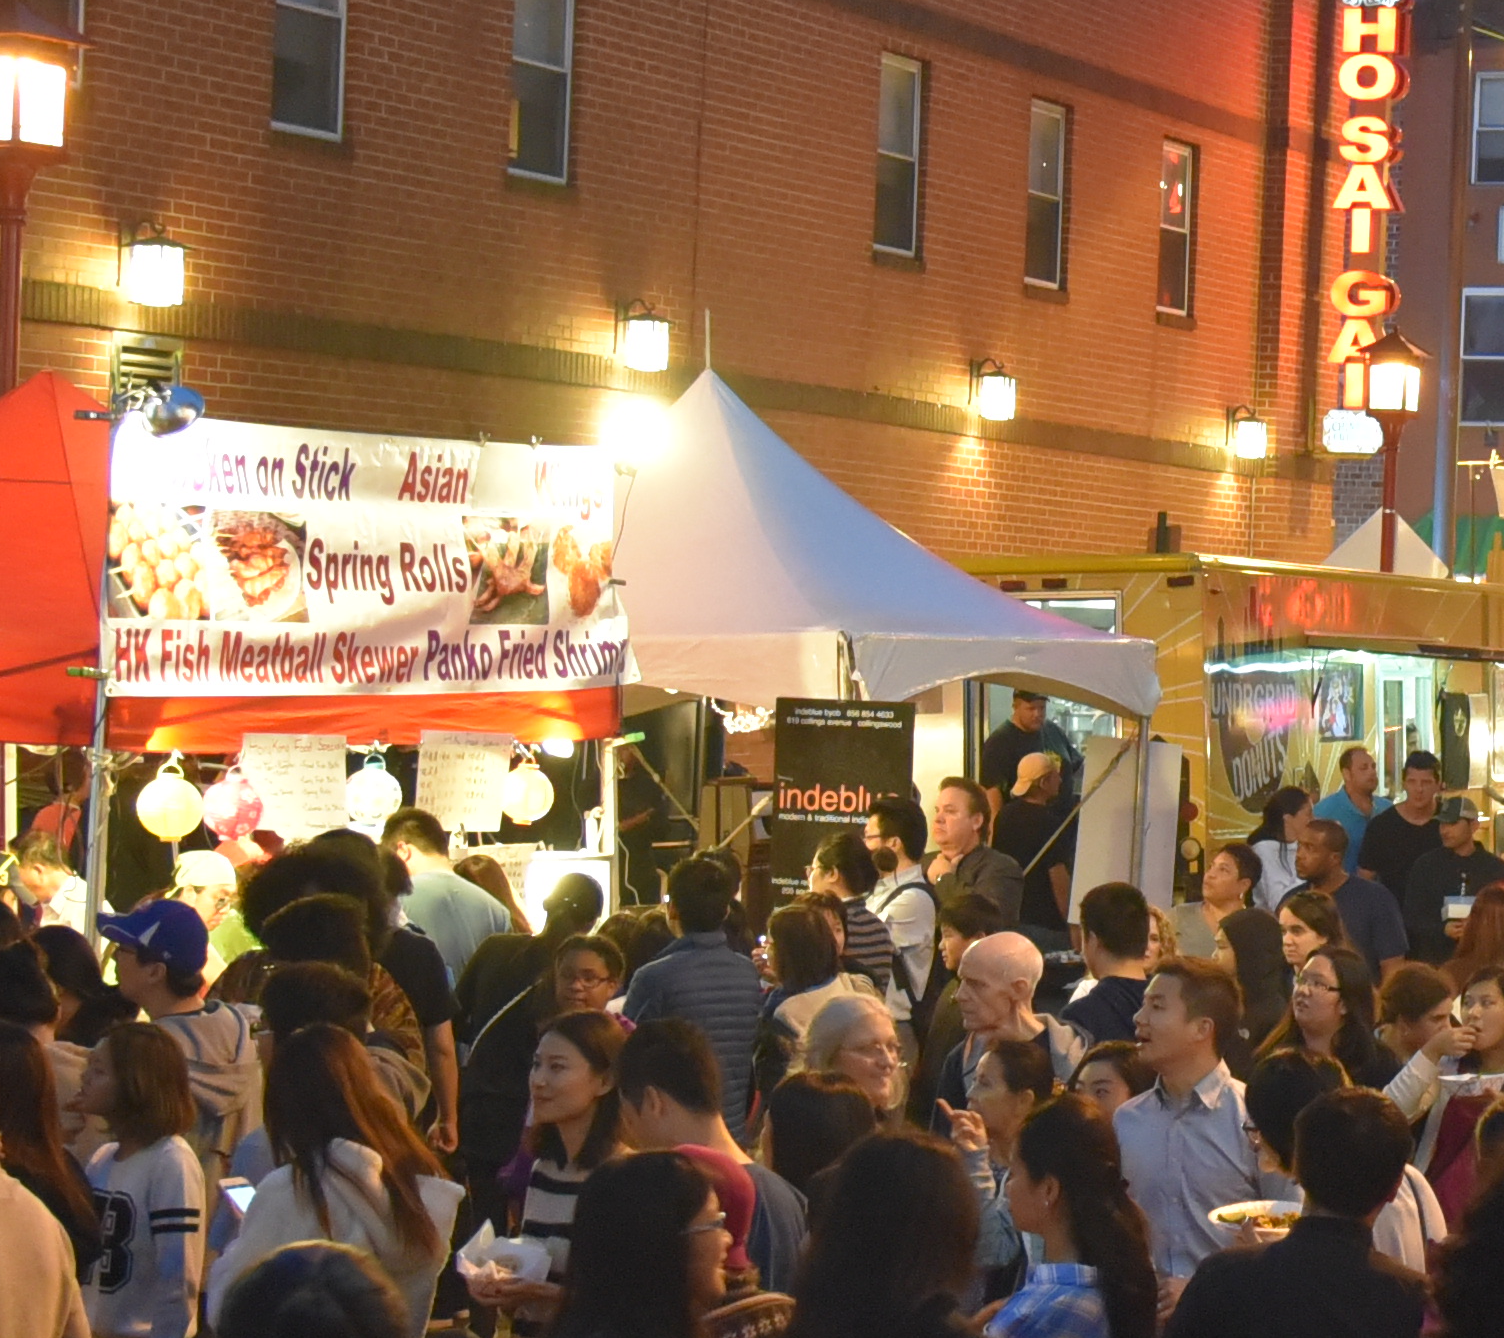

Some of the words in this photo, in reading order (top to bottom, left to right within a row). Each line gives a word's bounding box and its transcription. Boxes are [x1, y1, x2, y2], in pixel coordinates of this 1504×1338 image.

[1338, 7, 1397, 101] HO
[1333, 116, 1391, 254] SAI
[1327, 270, 1387, 410] GAI
[256, 456, 285, 497] on
[292, 443, 357, 502] Stick
[398, 451, 469, 504] Asian
[307, 537, 395, 606] Spring
[399, 541, 468, 593] Rolls
[115, 627, 152, 683] HK
[160, 628, 211, 683] Fish
[219, 630, 327, 684] Meatball
[330, 631, 420, 684] Skewer
[422, 629, 494, 682] Panko
[497, 629, 548, 680] Fried
[1211, 681, 1296, 717] UNDRGRND
[1232, 726, 1287, 803] DONUTS
[851, 815, 869, 825] india
